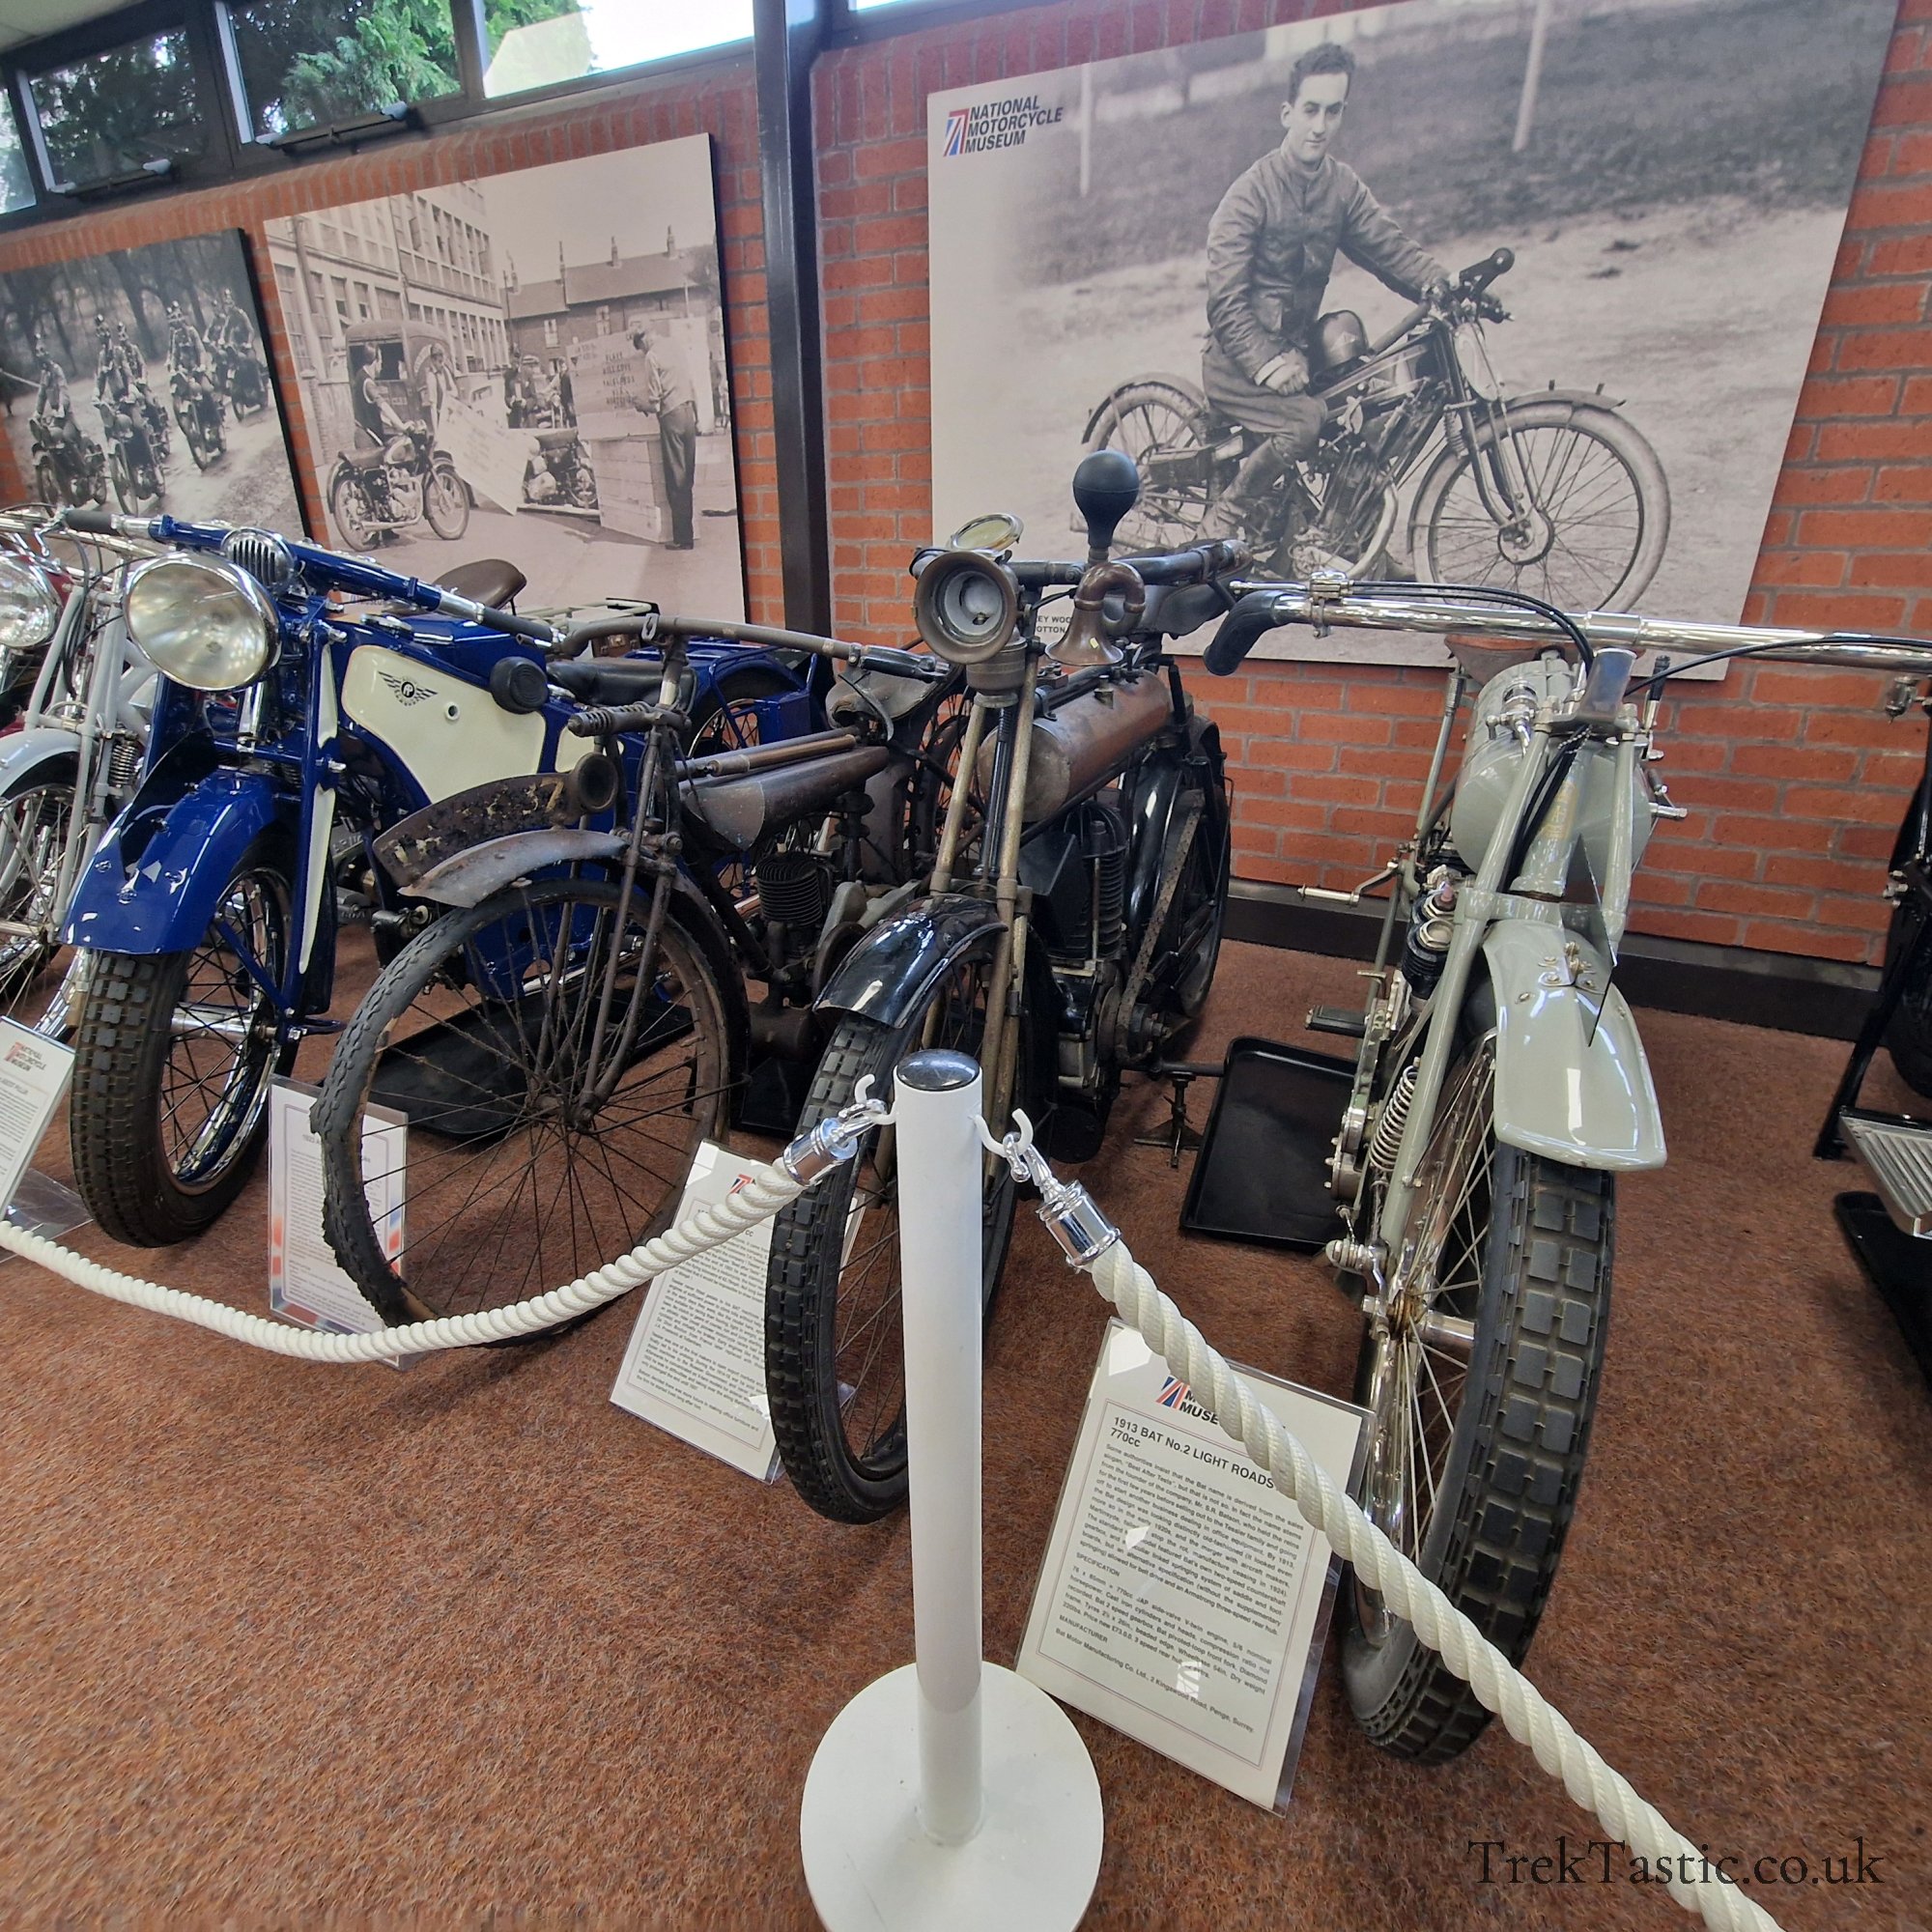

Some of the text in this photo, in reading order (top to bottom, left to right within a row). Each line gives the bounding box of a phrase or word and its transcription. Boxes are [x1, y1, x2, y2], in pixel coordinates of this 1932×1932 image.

[970, 95, 1039, 121] NATIONAL
[968, 107, 1064, 137] MOTORCYCLE
[965, 129, 1026, 154] MUSEUM
[1179, 1402, 1219, 1425] MUSE
[1110, 1427, 1142, 1448] 770cc
[1113, 1416, 1276, 1490] 1913 BAT No.2 LIGHT ROADS
